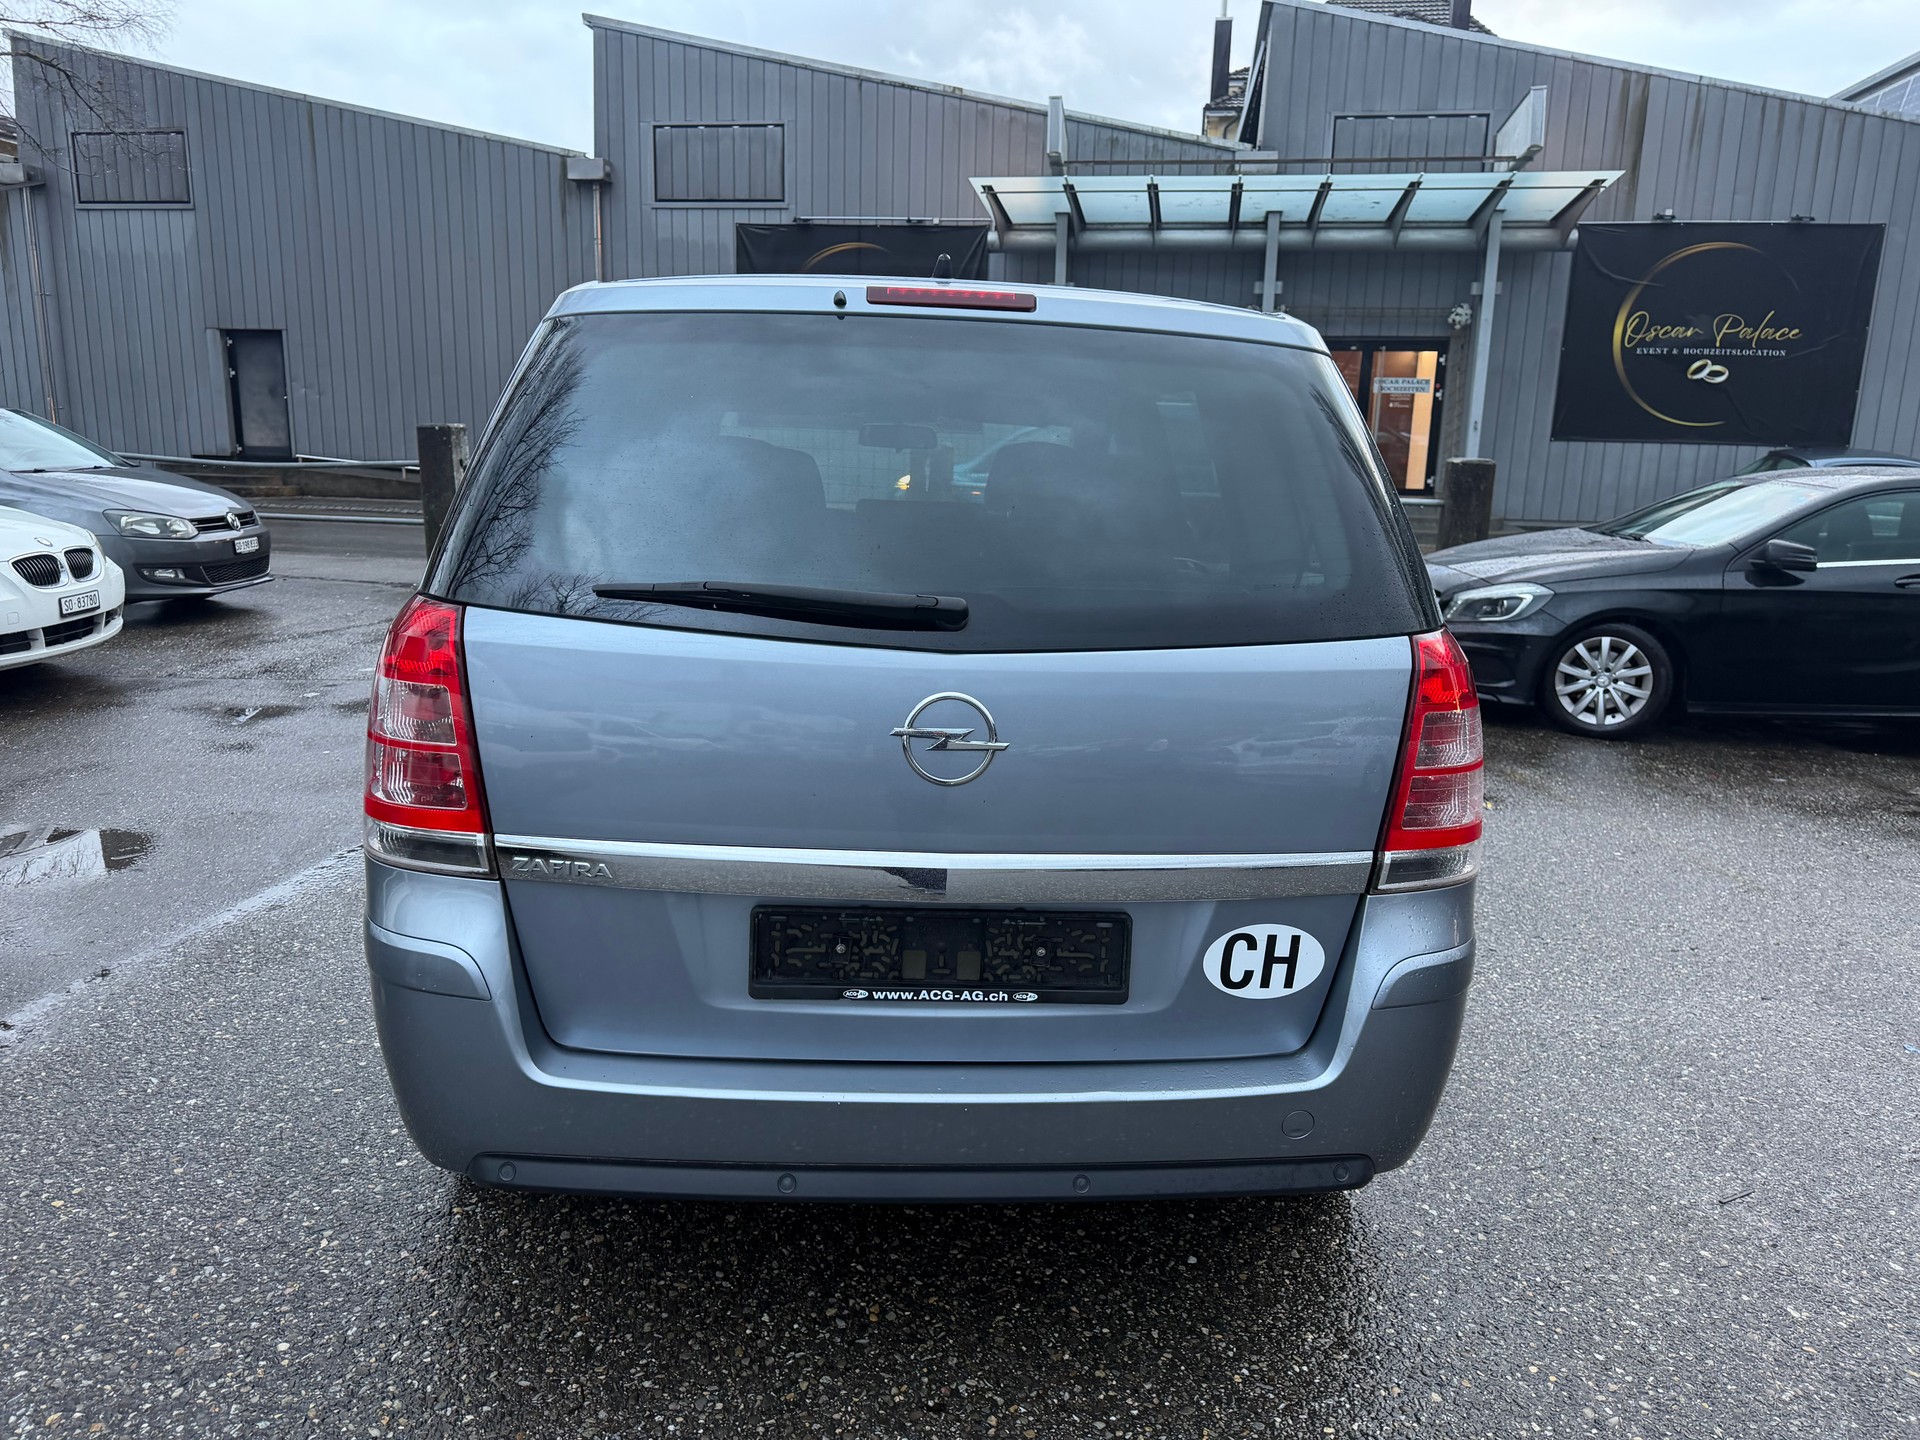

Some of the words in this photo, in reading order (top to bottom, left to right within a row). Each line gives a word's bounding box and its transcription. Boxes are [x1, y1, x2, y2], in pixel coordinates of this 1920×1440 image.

[1624, 311, 1704, 348] Oscar
[1713, 310, 1802, 348] Palace
[1636, 347, 1669, 355] EVENT
[1672, 347, 1679, 355] &
[1683, 347, 1787, 357] HOCHZEITSLOCATION
[512, 857, 613, 879] ZAFIRA
[1220, 933, 1301, 990] CH
[872, 989, 1008, 1002] www.ACG-AG.ch
